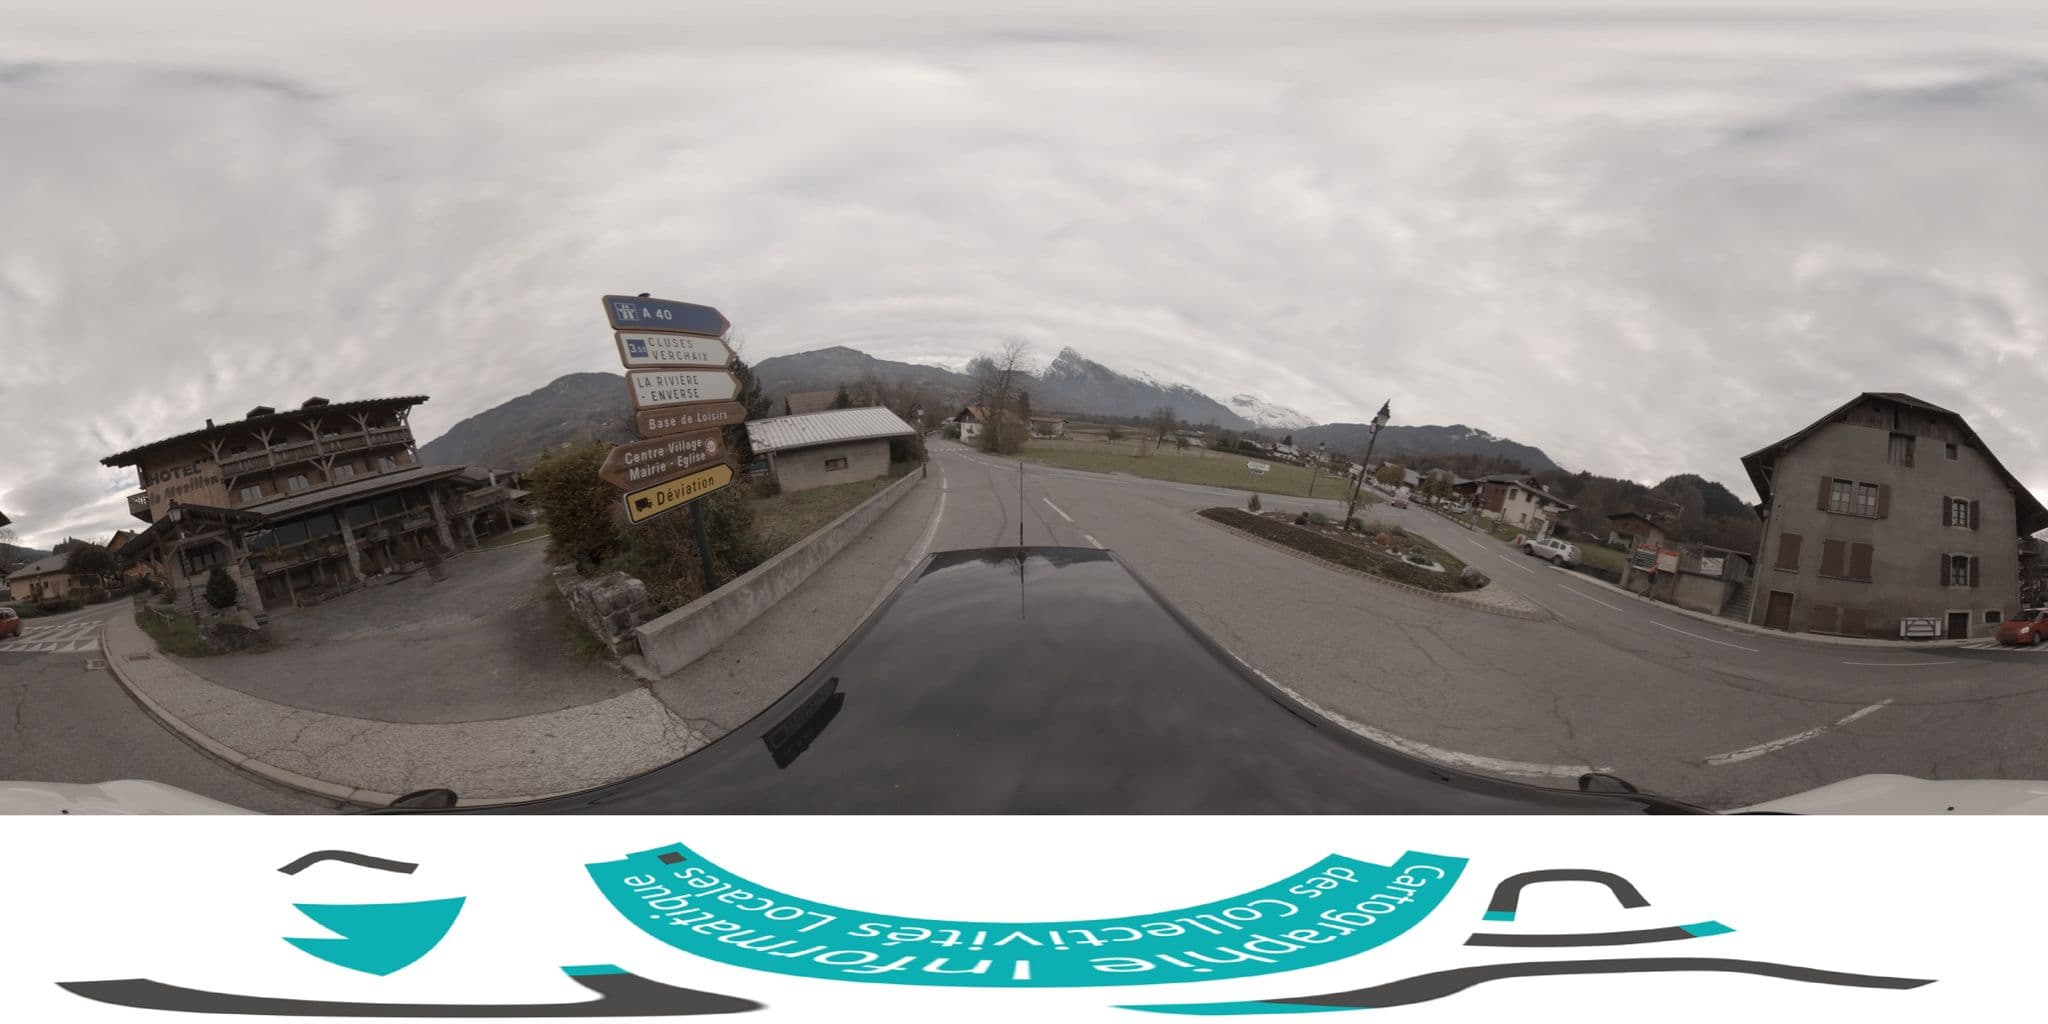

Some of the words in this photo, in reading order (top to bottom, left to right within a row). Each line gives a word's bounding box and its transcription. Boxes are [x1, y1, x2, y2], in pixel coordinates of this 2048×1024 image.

[642, 308, 652, 320] A
[656, 309, 673, 321] 40
[648, 337, 694, 349] CLUSES
[651, 350, 709, 361] VERCHAIX
[637, 377, 652, 389] LA
[656, 373, 700, 387] RIVIÈRE
[651, 388, 700, 402] ENVERSE
[649, 417, 676, 431] Base
[681, 414, 693, 425] de
[697, 410, 728, 423] Loisirs
[625, 447, 665, 465] Centre
[668, 438, 702, 454] Village
[629, 462, 667, 481] Mairie
[677, 452, 706, 468] Eglise
[656, 476, 715, 506] Déviation
